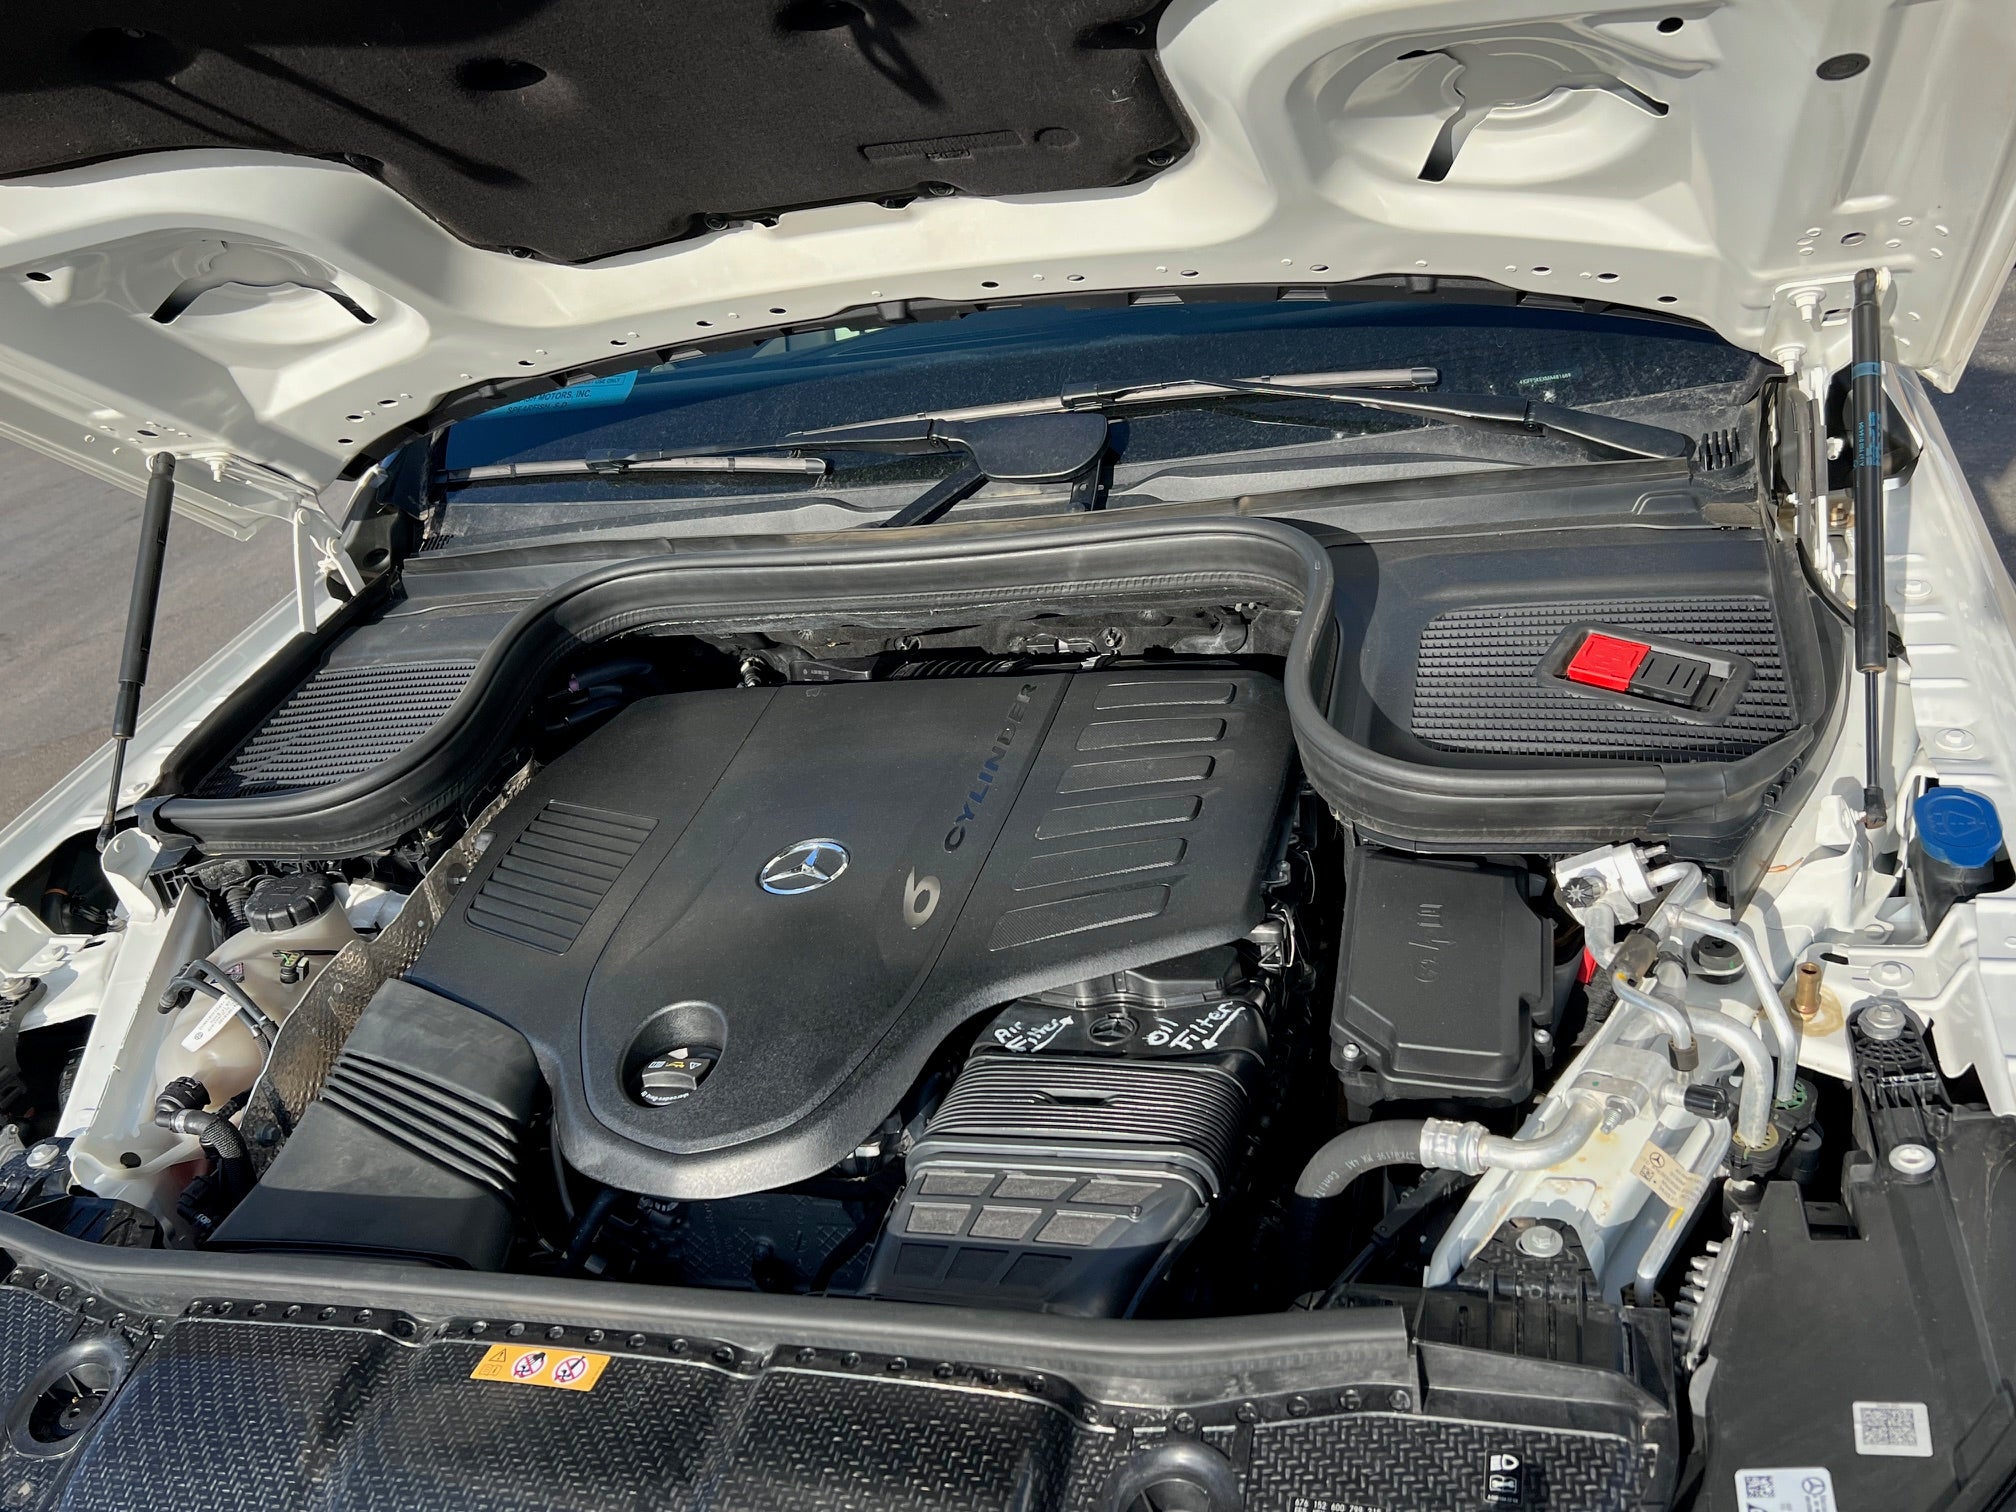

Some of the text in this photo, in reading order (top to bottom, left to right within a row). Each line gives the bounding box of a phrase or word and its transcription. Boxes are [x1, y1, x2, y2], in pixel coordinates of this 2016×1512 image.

[903, 683, 1037, 930] 6 CYLINDER
[1143, 1016, 1179, 1046] Oil
[1168, 1001, 1233, 1051] Filter
